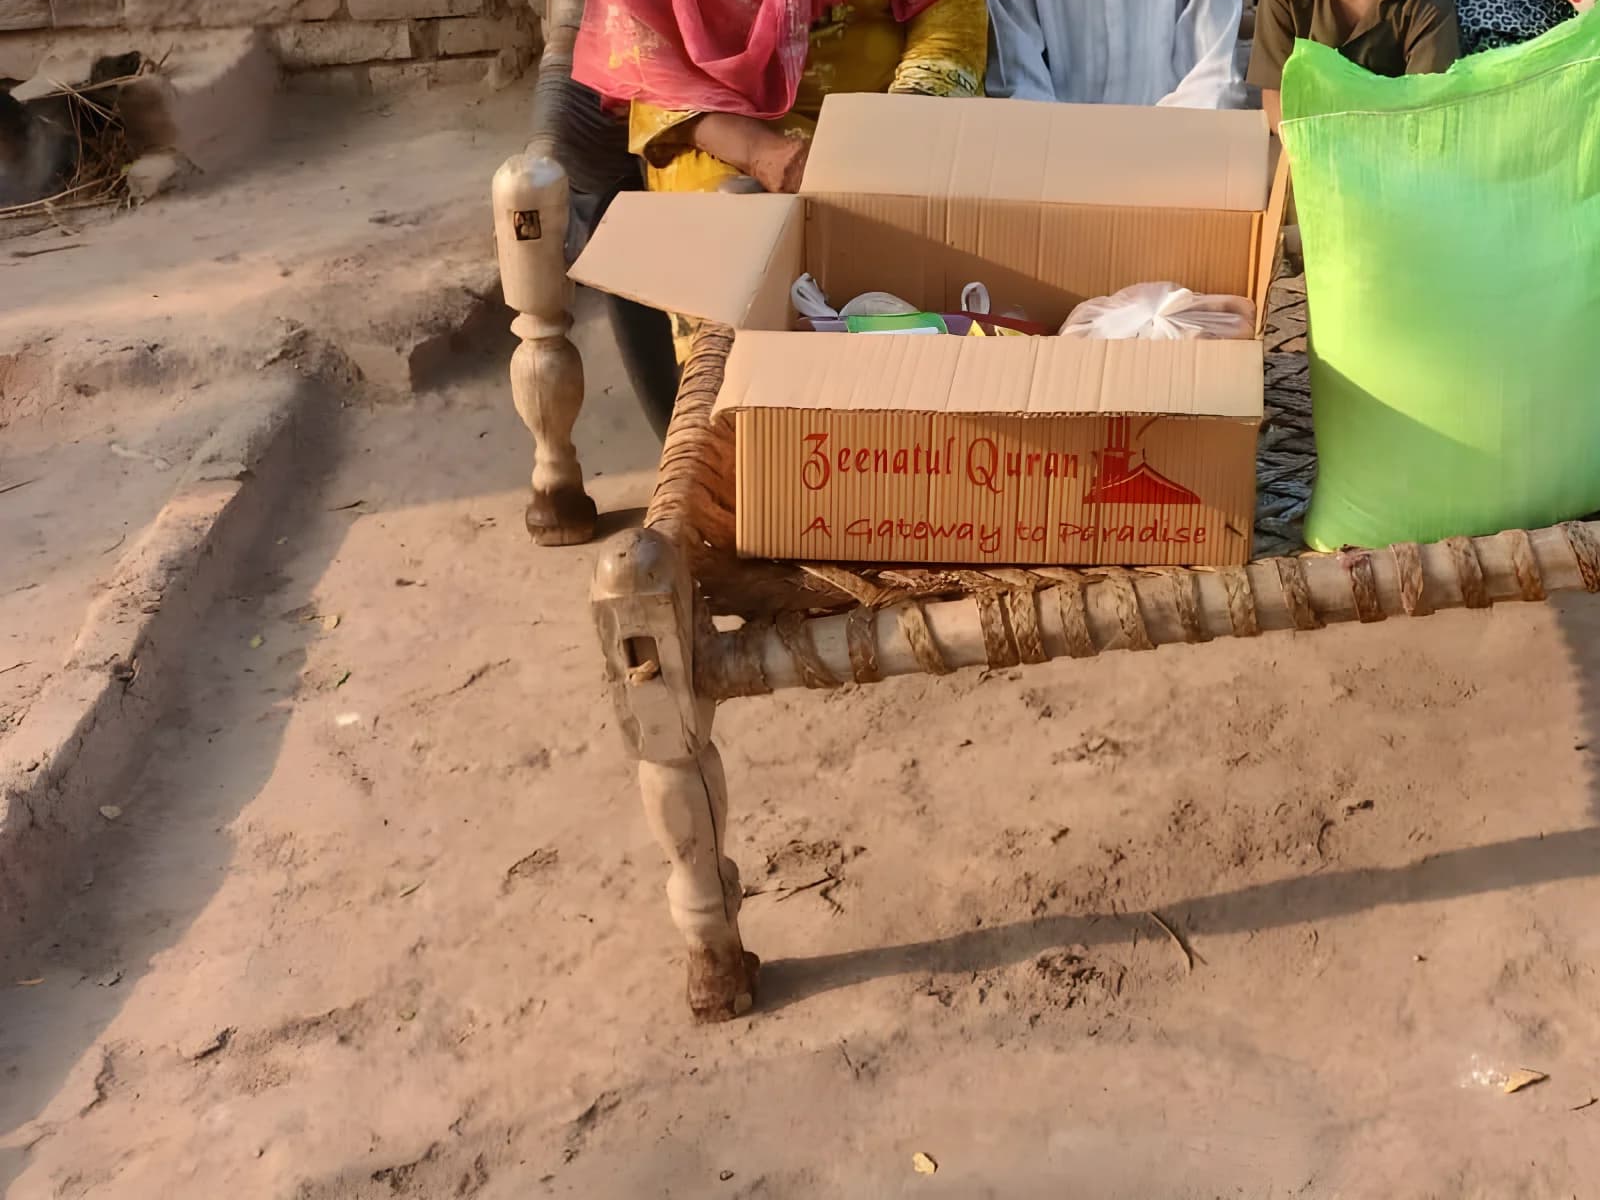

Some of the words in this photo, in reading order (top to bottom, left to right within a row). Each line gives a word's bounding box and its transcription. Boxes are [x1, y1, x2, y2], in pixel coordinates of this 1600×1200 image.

[802, 433, 956, 490] Zeenatul
[967, 437, 1078, 494] Quran
[801, 516, 832, 539] A
[1016, 520, 1047, 542] to
[1059, 518, 1206, 544] Paradise
